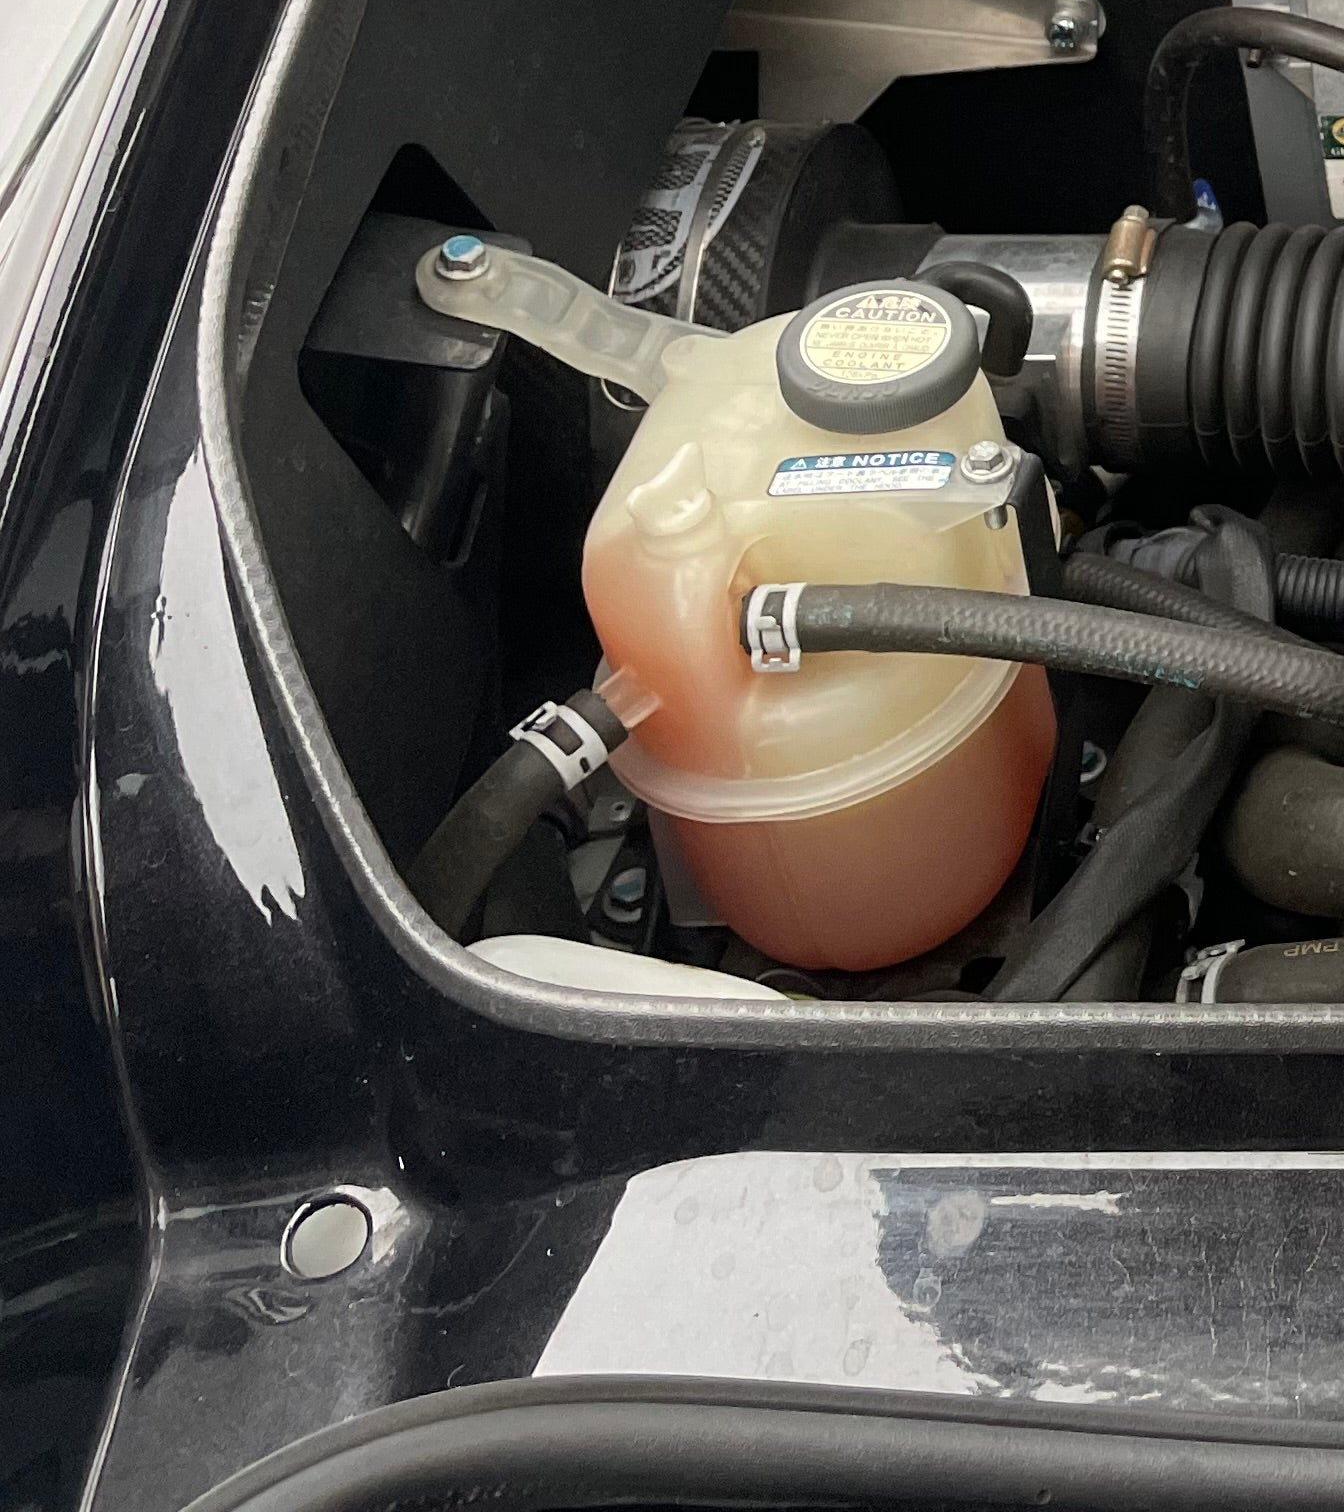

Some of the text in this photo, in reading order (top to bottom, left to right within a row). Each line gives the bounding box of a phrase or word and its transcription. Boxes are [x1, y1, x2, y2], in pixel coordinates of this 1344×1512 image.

[835, 307, 937, 324] CAUTION
[832, 350, 904, 362] ENGINE
[822, 359, 906, 370] COOLANT
[852, 452, 941, 468] NOTICE
